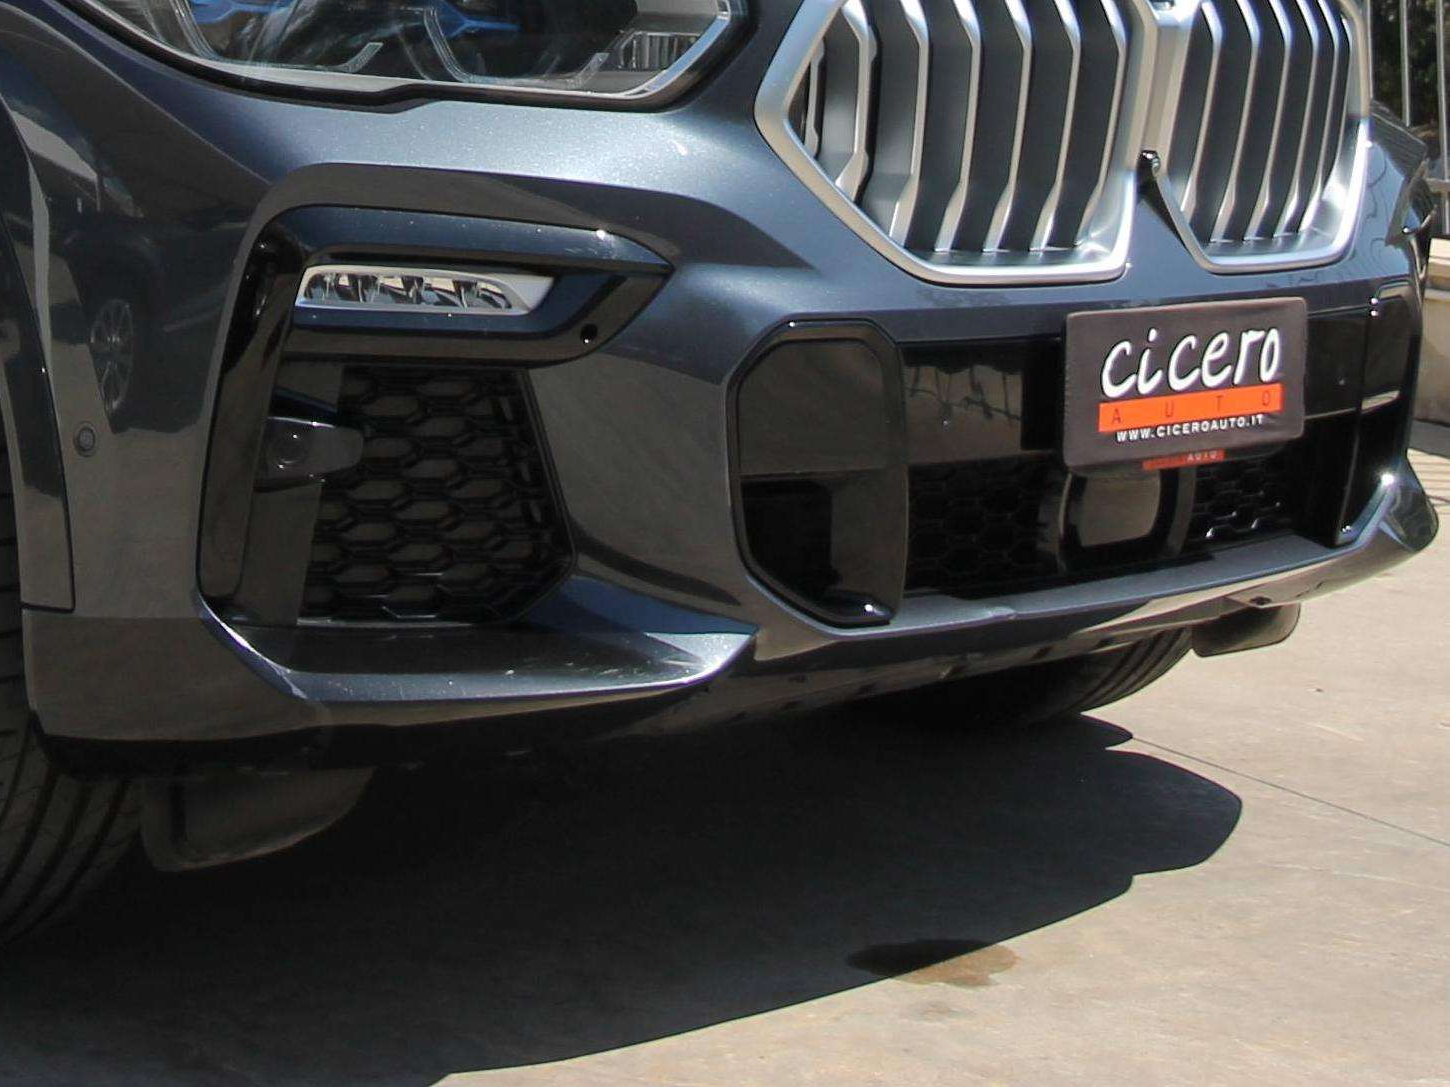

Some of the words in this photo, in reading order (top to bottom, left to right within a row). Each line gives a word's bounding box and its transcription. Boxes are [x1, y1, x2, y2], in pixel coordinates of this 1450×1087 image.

[1101, 328, 1281, 399] cicero
[1110, 390, 1272, 425] AUTO
[1116, 413, 1264, 442] WWW.CICEROAUTO.IT
